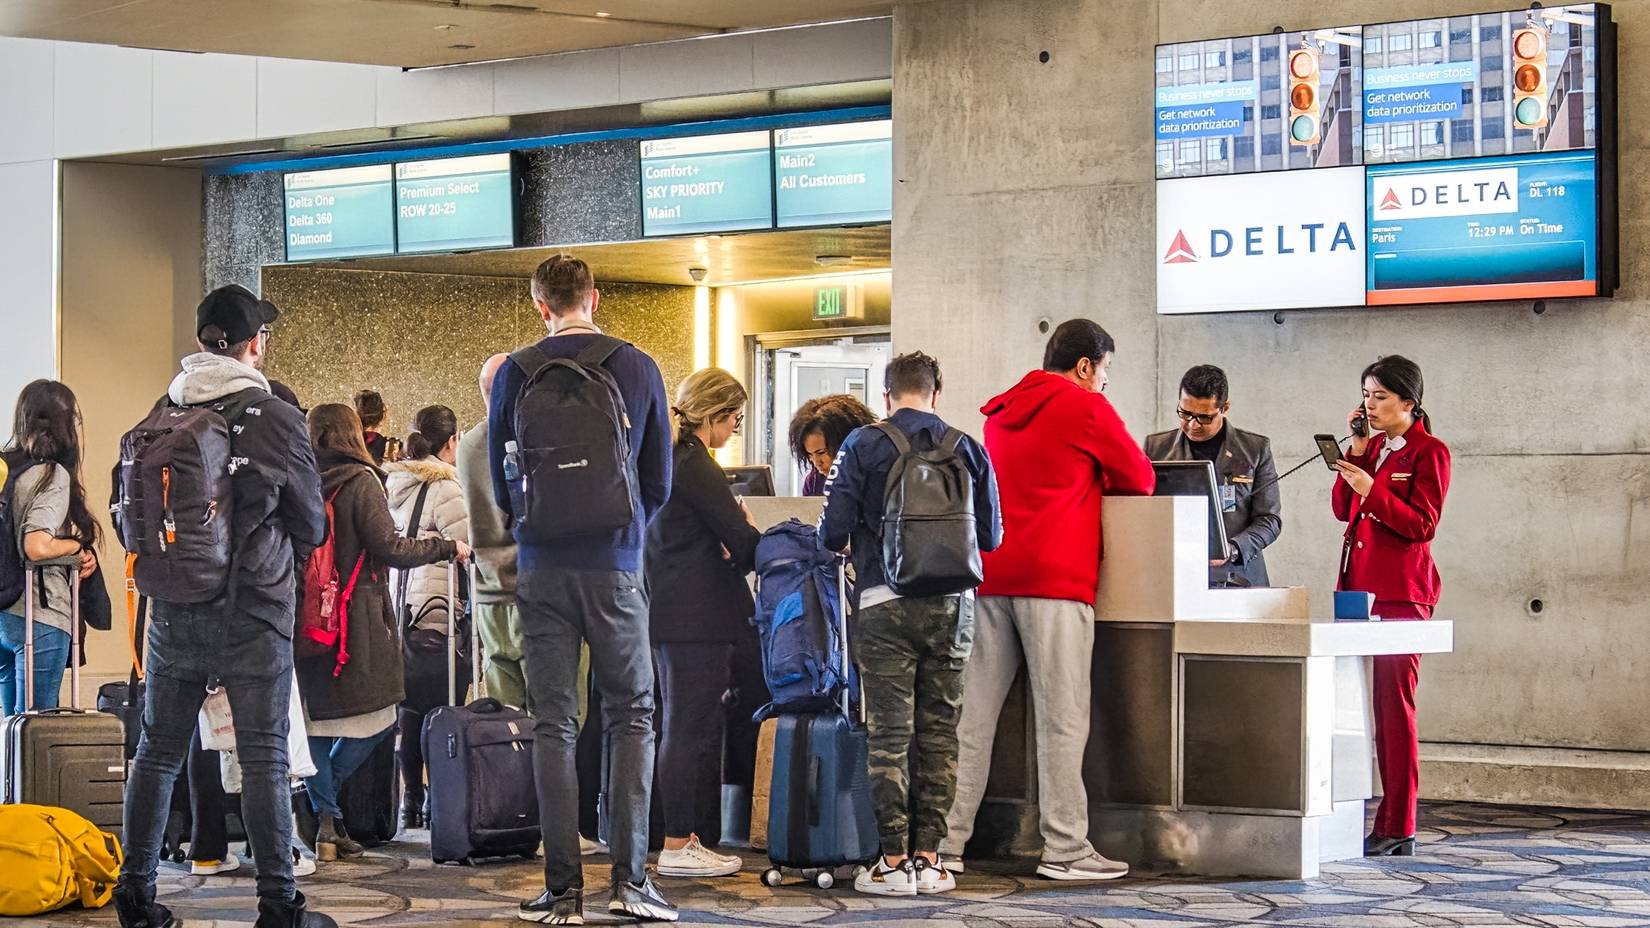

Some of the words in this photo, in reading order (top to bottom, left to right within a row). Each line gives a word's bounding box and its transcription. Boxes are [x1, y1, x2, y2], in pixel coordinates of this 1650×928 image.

[1412, 69, 1441, 80] never
[1443, 67, 1472, 79] stops
[1367, 93, 1386, 104] Get
[1387, 89, 1431, 102] network
[1159, 110, 1176, 121] Get
[1177, 106, 1216, 119] network
[1367, 105, 1390, 117] data
[1392, 101, 1457, 118] prioritization
[1159, 122, 1180, 134] data
[1181, 119, 1240, 134] prioritization
[780, 153, 815, 169] Main2
[645, 164, 699, 179] Comfort+
[780, 175, 796, 189] All
[799, 172, 866, 188] Customers
[400, 185, 445, 199] Premium
[447, 182, 479, 195] Select
[646, 185, 668, 199] SKY
[670, 181, 725, 197] PRIORITY
[1411, 181, 1511, 207] DELTA
[1530, 187, 1543, 198] DL
[1546, 185, 1565, 197] 118
[288, 196, 313, 209] Delta
[315, 194, 335, 207] One
[400, 204, 426, 218] ROW
[428, 202, 456, 216] 20-25
[647, 204, 681, 220] Main1
[289, 214, 313, 227] Delta
[315, 212, 332, 225] 360
[1468, 226, 1497, 238] 12:29
[1499, 225, 1514, 236] PM
[1520, 224, 1534, 235] On
[1536, 223, 1564, 234] Time
[289, 231, 332, 246] Diamond
[1210, 222, 1356, 258] DELTA
[1372, 233, 1396, 243] Paris
[818, 288, 840, 316] EXIT
